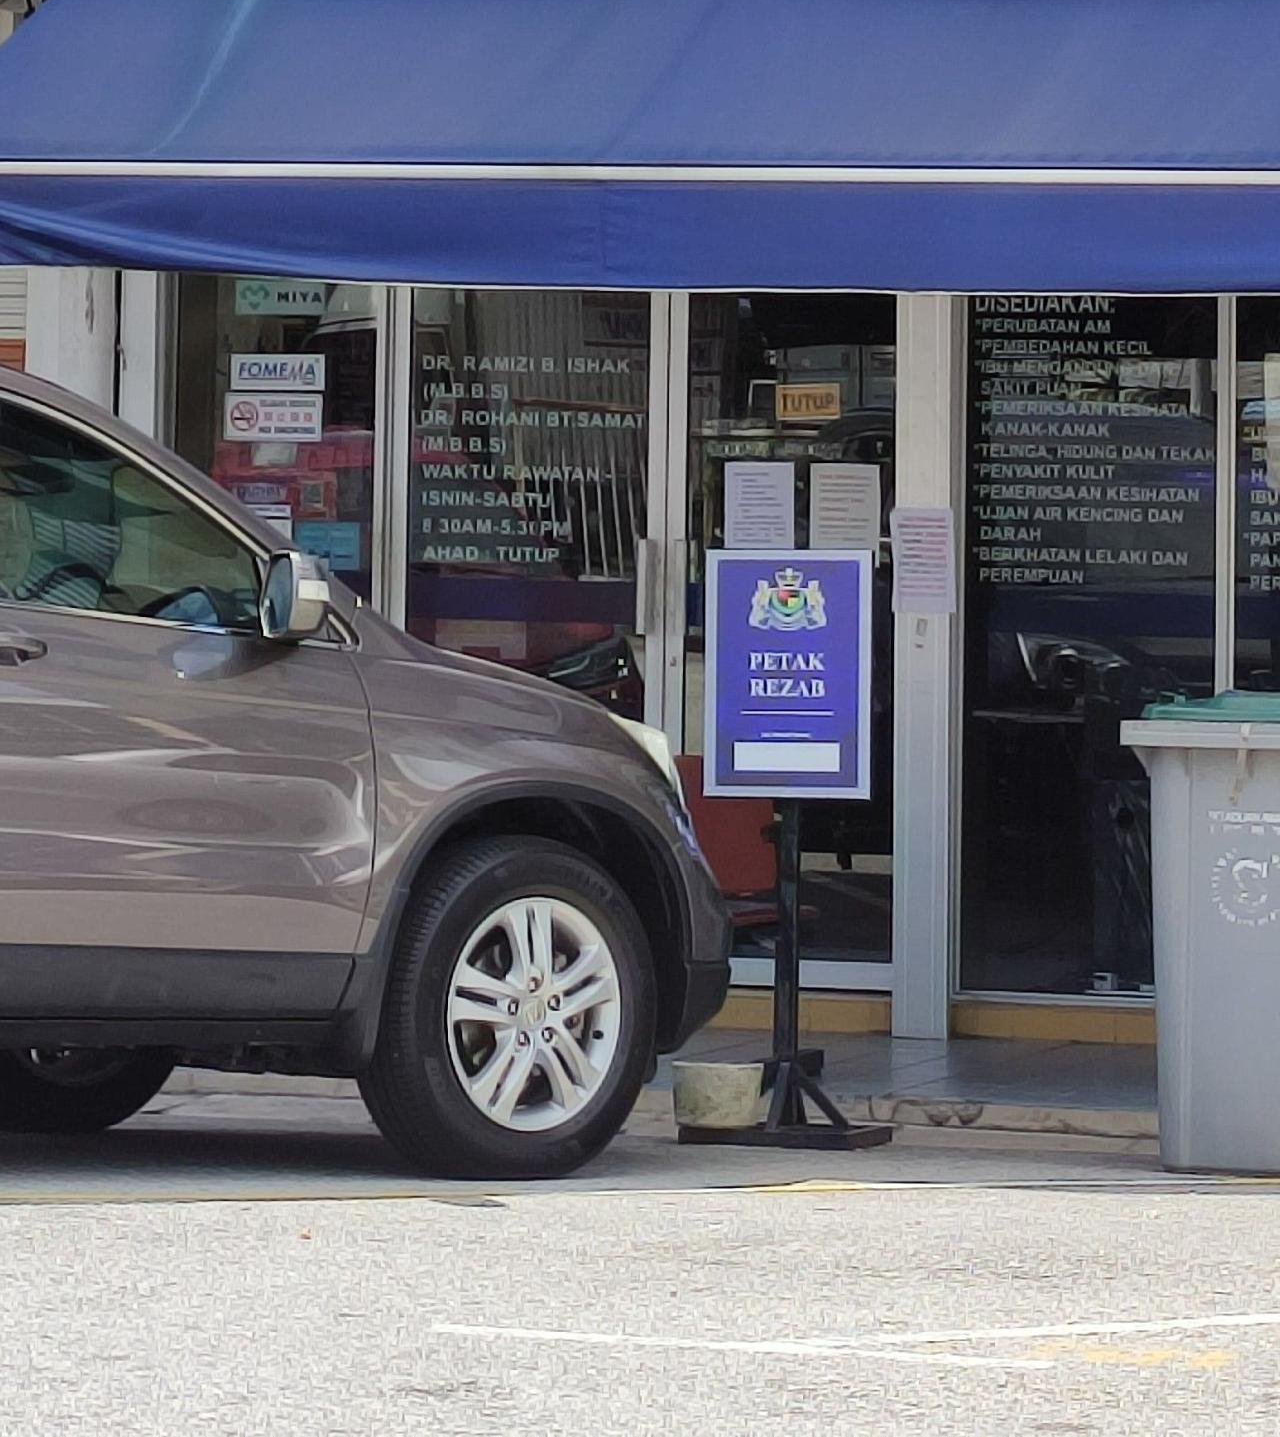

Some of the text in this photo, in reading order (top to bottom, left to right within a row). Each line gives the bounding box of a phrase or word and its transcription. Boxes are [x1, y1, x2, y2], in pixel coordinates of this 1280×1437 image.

[981, 318, 1111, 335] PERUBATAN AM
[1104, 340, 1153, 356] KECIL
[463, 355, 535, 373] RAMIZI
[568, 357, 631, 374] ISHAK
[461, 410, 540, 427] ROHANI
[981, 421, 1111, 437] KANAK-KANAK
[1057, 444, 1117, 460] HIDUNG
[1121, 445, 1156, 461] DAN
[422, 464, 496, 480] WAKTU
[980, 464, 1116, 480] PENYAKIT KULIT
[422, 490, 551, 508] ISNIN-SABTU
[979, 484, 1201, 503] PEMERIKSAAN KESIHATAN
[1033, 507, 1063, 522] AIR
[1066, 507, 1143, 523] KENCING
[1148, 509, 1185, 524] DAN
[980, 526, 1042, 542] DARAH
[423, 545, 478, 562] AHAD
[497, 546, 561, 563] TUTUP
[1085, 549, 1148, 564] LELAKI
[1152, 550, 1189, 566] DAN
[979, 568, 1084, 584] PEREMPUAN
[749, 652, 825, 671] PETAK
[750, 679, 825, 697] REZAB
